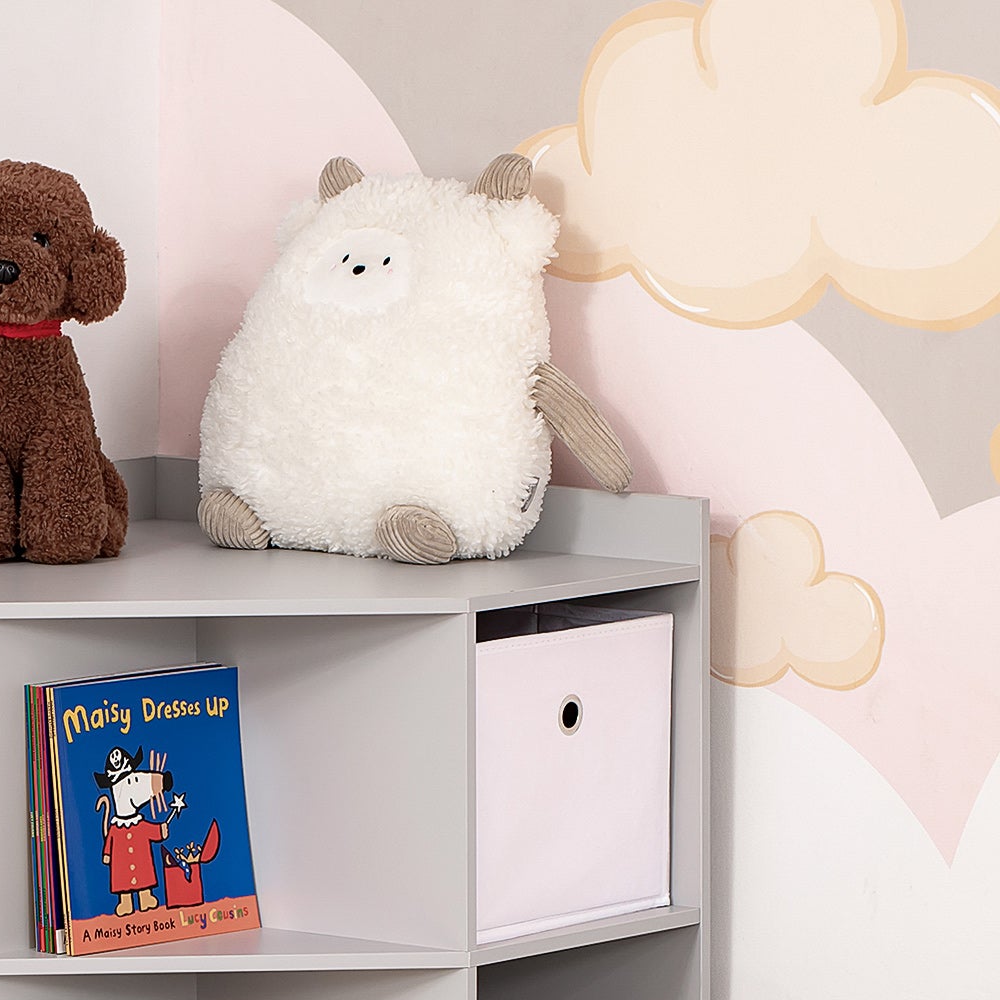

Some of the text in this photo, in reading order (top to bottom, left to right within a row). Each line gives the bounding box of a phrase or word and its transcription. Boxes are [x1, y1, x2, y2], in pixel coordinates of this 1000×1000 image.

[62, 699, 132, 744] Maisy
[141, 697, 201, 723] Dresses
[179, 905, 249, 929] Lucy Cousins
[82, 918, 176, 943] A Maisy Story Book
